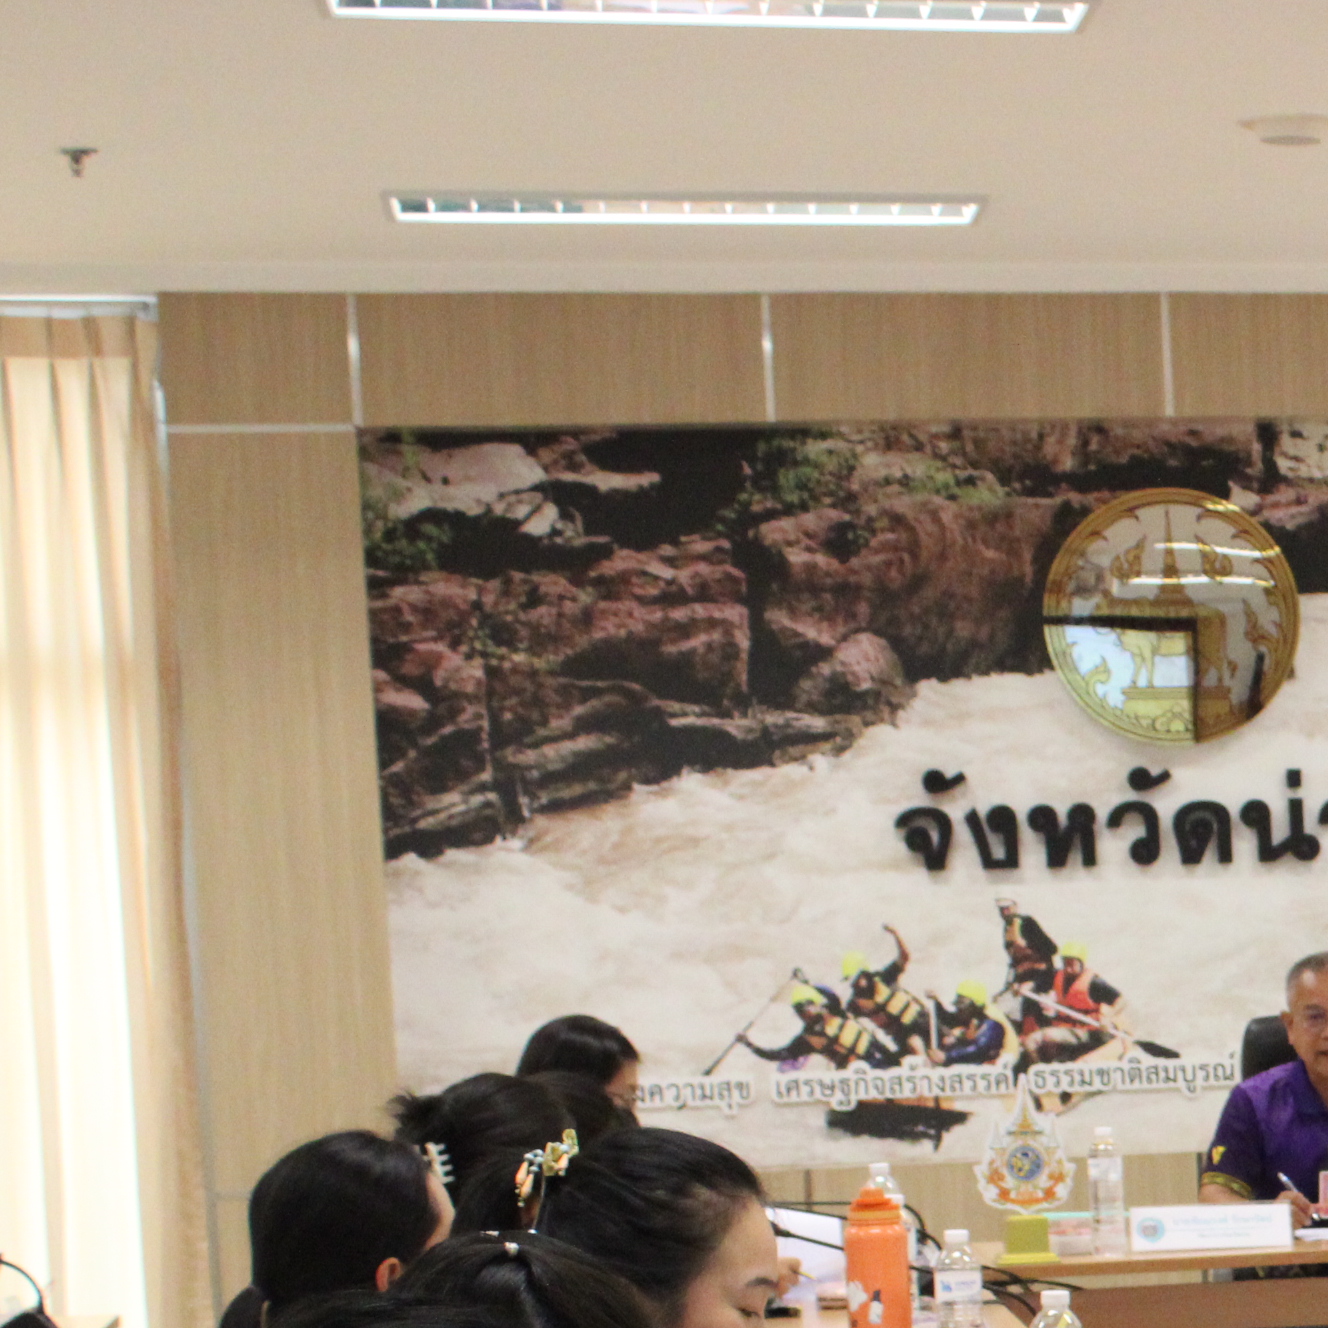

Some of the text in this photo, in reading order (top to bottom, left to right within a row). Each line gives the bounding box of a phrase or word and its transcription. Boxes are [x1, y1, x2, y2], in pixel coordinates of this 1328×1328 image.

[776, 1061, 1009, 1107] เศรษฐกิจสร้างสรรค์
[1033, 1051, 1235, 1092] ธรรมชาติสมบูรณ์
